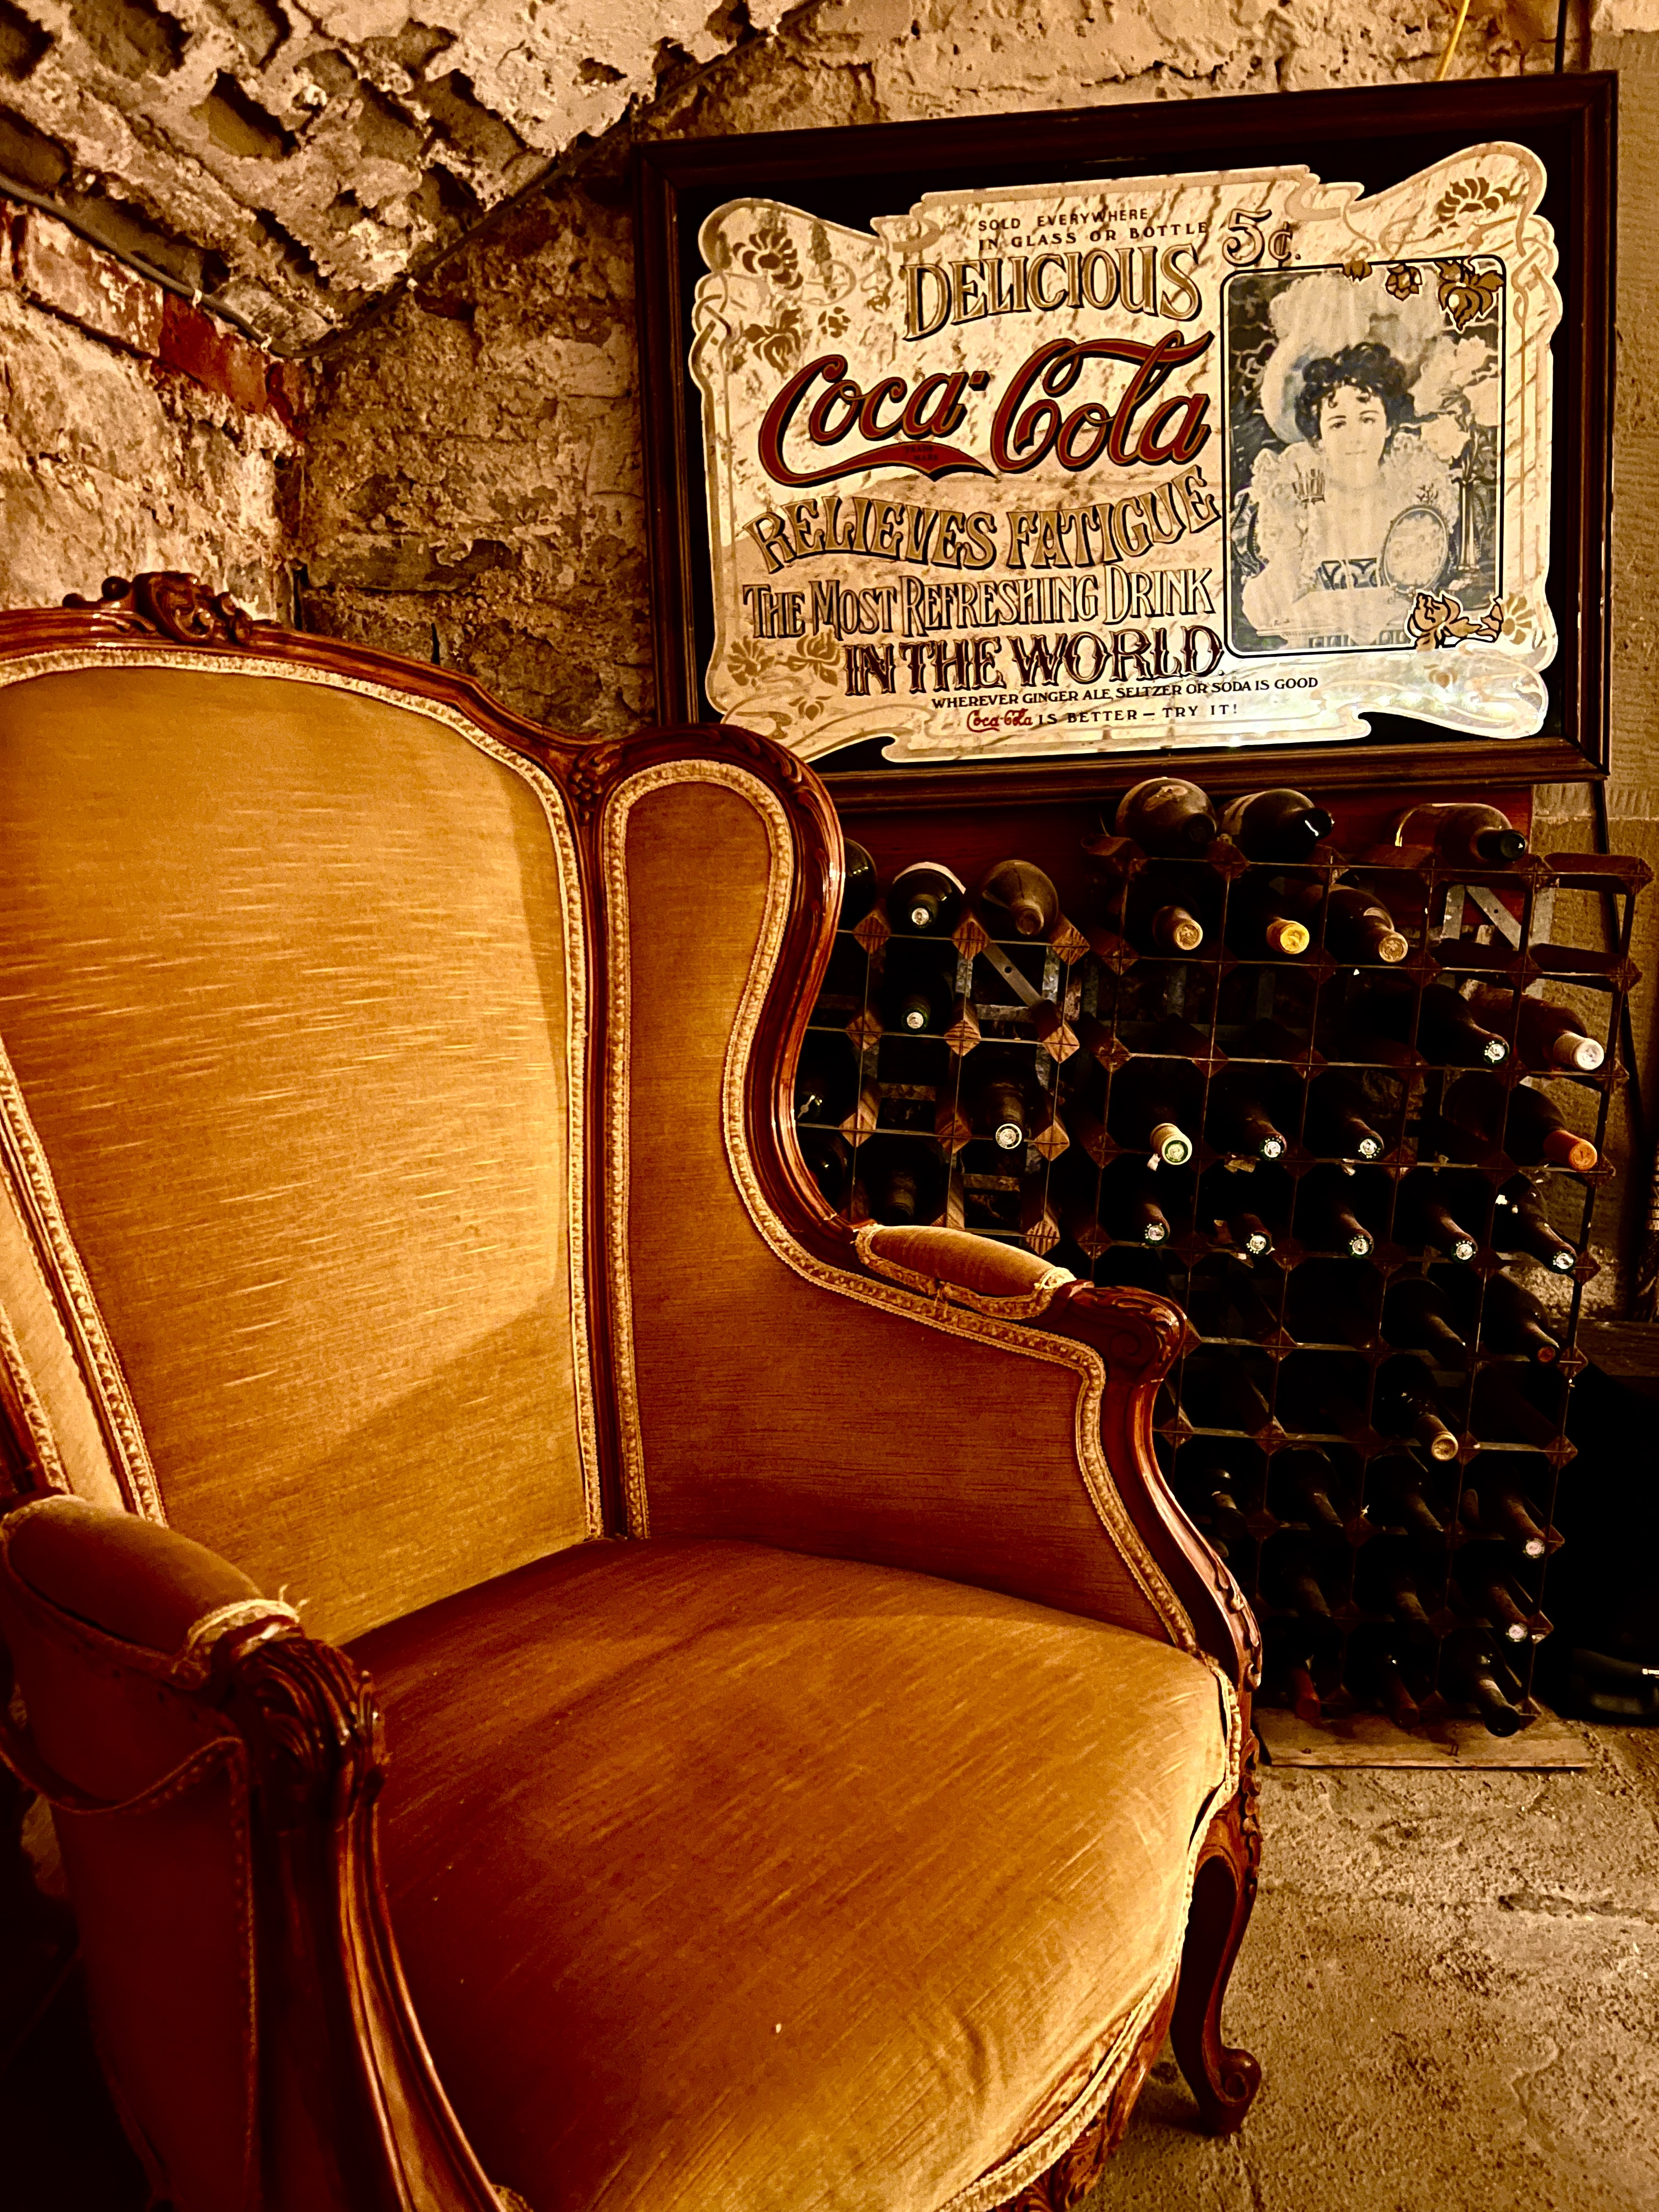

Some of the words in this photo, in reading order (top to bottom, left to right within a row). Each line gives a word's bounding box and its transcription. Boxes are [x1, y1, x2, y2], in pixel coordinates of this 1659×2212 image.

[978, 217, 1020, 232] SOLD
[1037, 208, 1148, 227] EVERYWHERE
[979, 238, 998, 251] IN
[1012, 232, 1076, 247] GLASS
[1090, 229, 1116, 242] OR
[1130, 222, 1206, 239] BOTTLE
[901, 243, 1202, 341] DELICIOUS
[742, 496, 997, 574] RELIEVES
[1006, 465, 1222, 569] FATIGUE
[742, 584, 805, 639] THE
[809, 579, 898, 641] MOST
[898, 574, 1098, 637] REFRESHING
[1103, 565, 1216, 625] DRINK
[842, 643, 897, 697] IN
[898, 636, 1007, 693] THE
[1010, 625, 1225, 687] WORLD.
[933, 694, 1019, 709] WHEREVER
[1022, 691, 1079, 704] GINGER
[1115, 685, 1182, 698] SELTZER
[1186, 683, 1209, 695] OR
[1211, 681, 1251, 693] SODA
[1255, 680, 1269, 691] IS
[1274, 678, 1318, 690] GOOD
[1039, 714, 1058, 725] IS
[1068, 710, 1137, 723] BETTER
[1163, 705, 1198, 718] TRY
[1211, 704, 1237, 715] IT!
